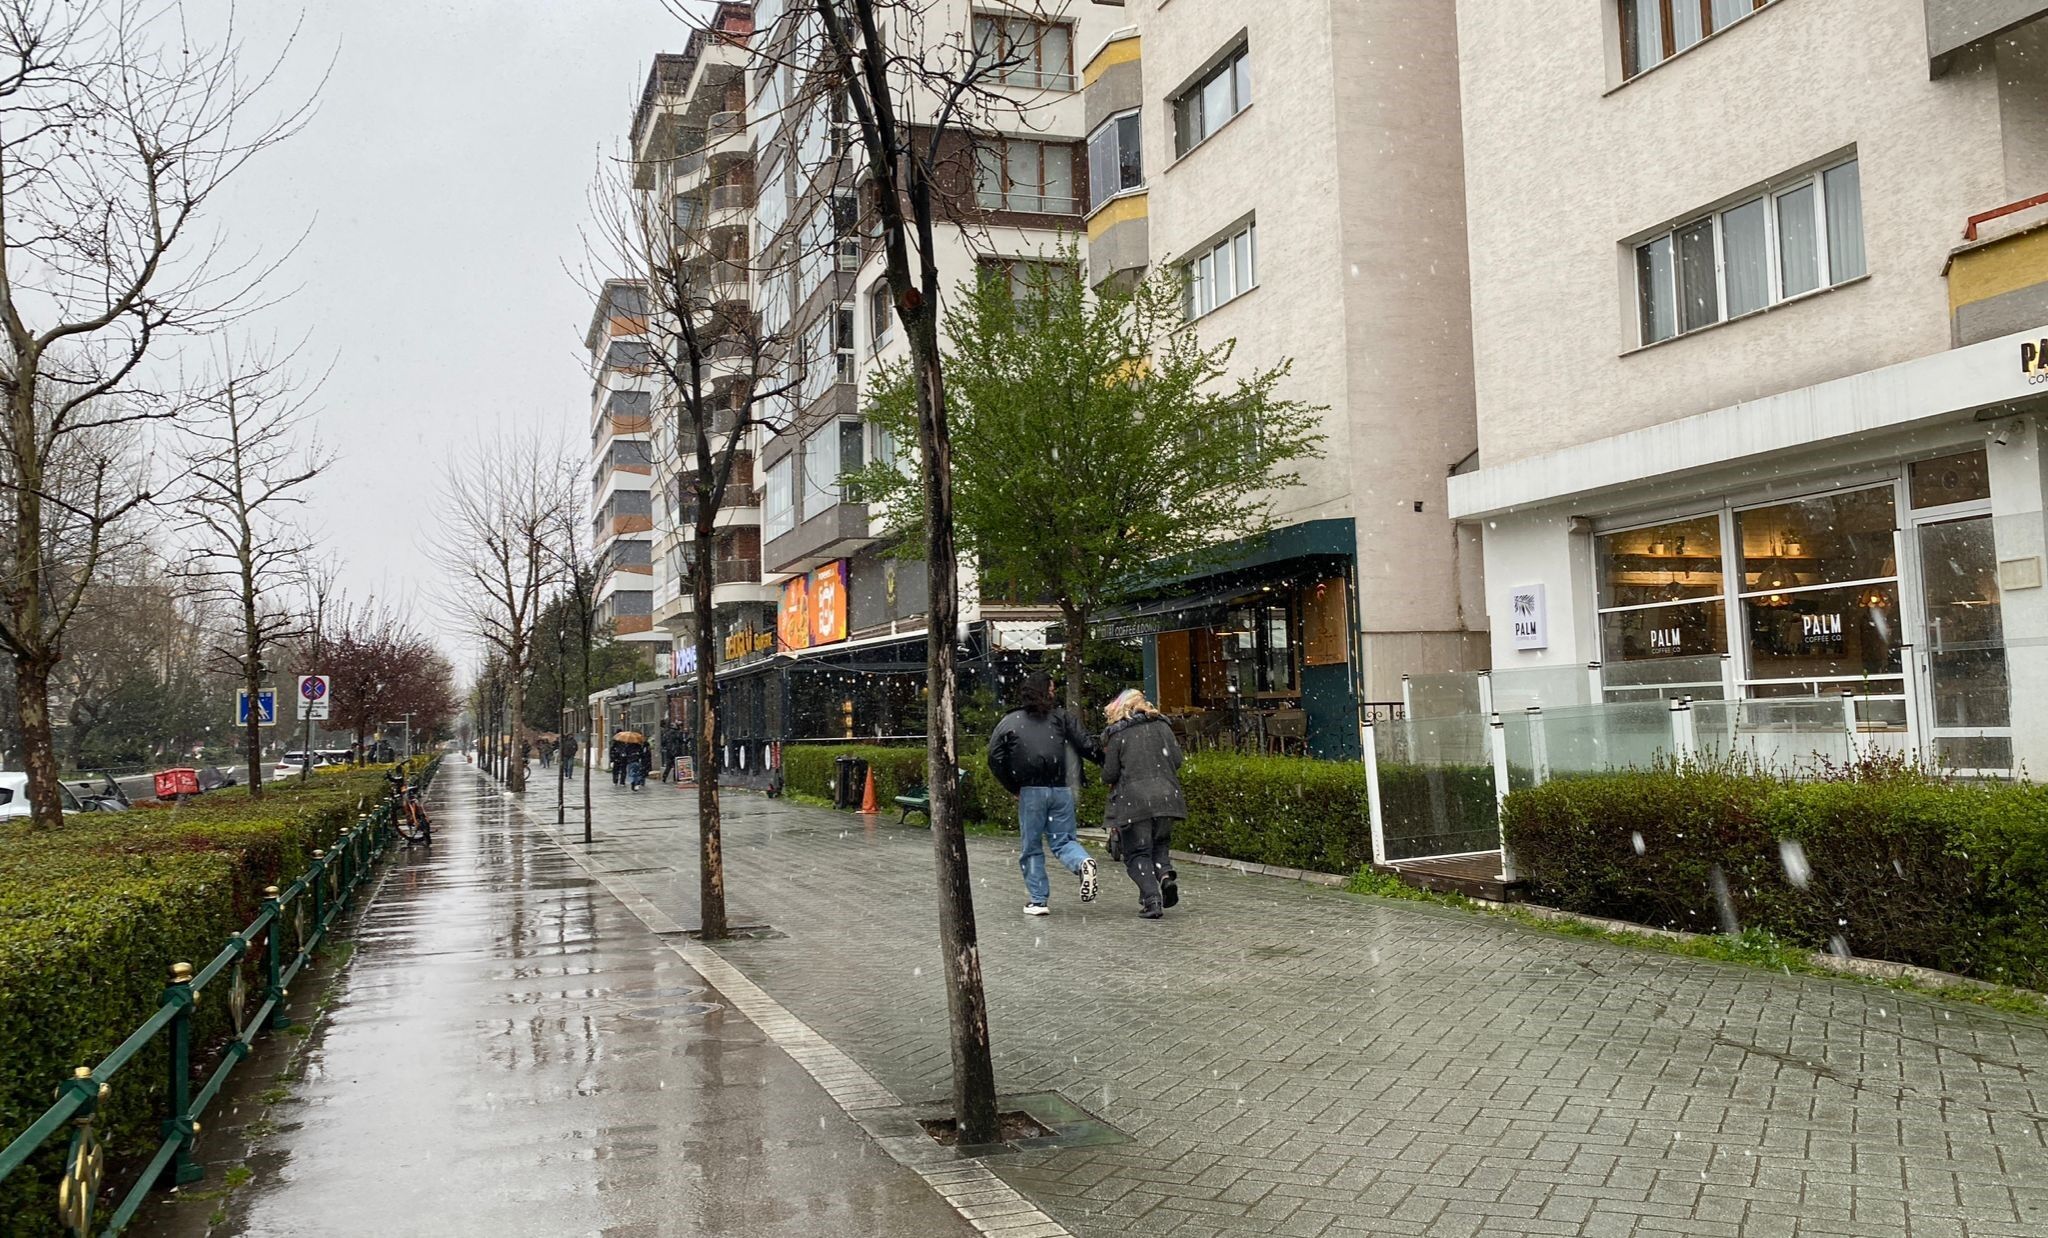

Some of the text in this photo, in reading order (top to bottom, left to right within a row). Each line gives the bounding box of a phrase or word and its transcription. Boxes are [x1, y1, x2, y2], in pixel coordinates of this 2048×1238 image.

[1515, 621, 1537, 636] PALM
[1803, 613, 1841, 636] PALM
[1650, 627, 1681, 648] PALM
[1804, 635, 1830, 643] COFFEE
[1651, 647, 1671, 655] COFFEE
